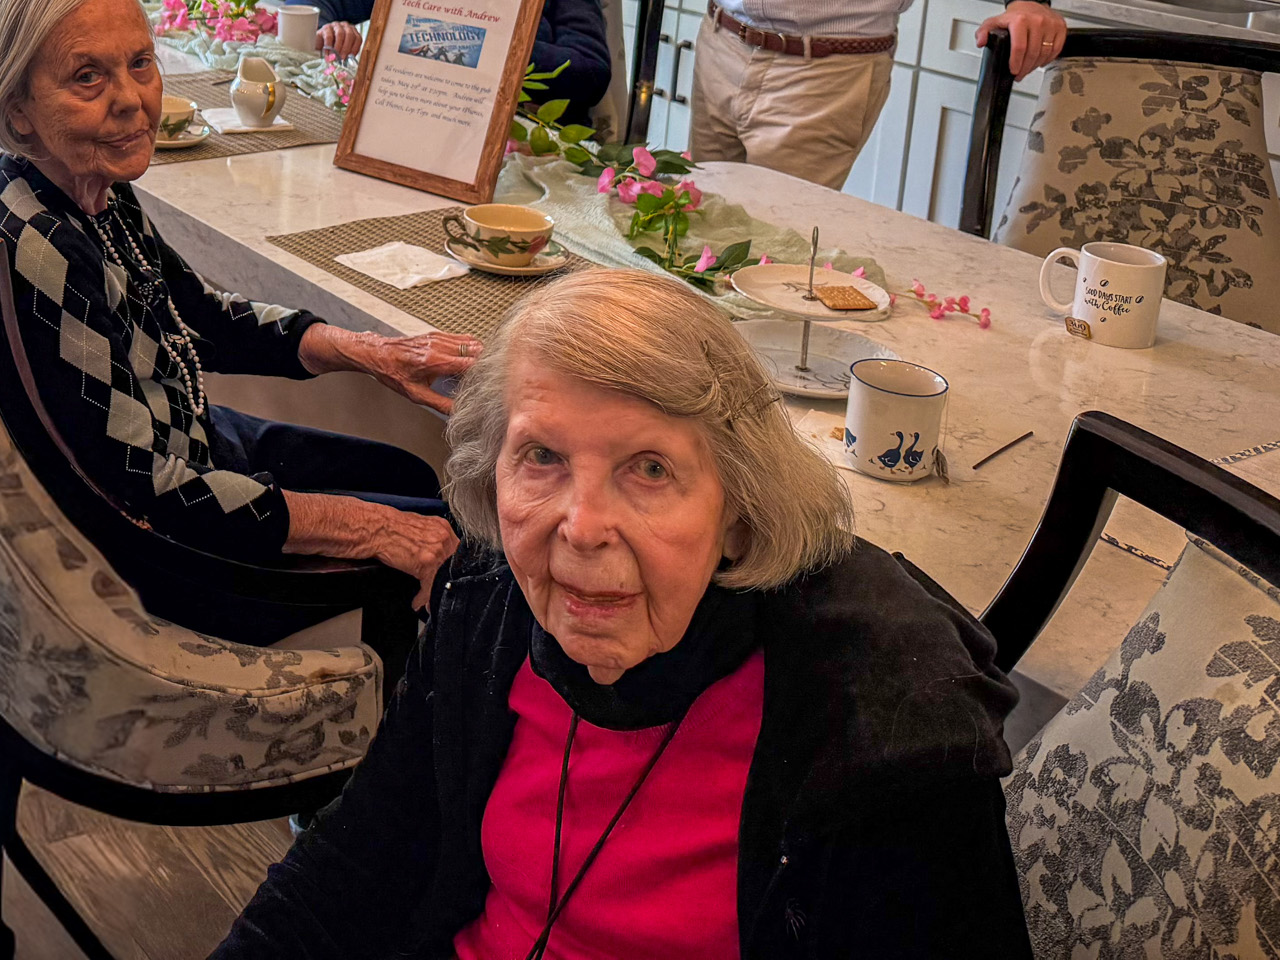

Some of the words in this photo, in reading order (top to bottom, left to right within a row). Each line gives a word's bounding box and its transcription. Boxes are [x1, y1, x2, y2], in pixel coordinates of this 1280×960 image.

[422, 1, 441, 11] Care
[444, 6, 463, 16] with
[464, 10, 500, 22] Andrew
[409, 30, 481, 43] TECHNOLOGY
[1085, 287, 1098, 297] GOOD
[1098, 290, 1114, 301] DAYS
[1114, 294, 1132, 305] START
[1084, 298, 1101, 309] with
[1102, 301, 1131, 316] Coffee
